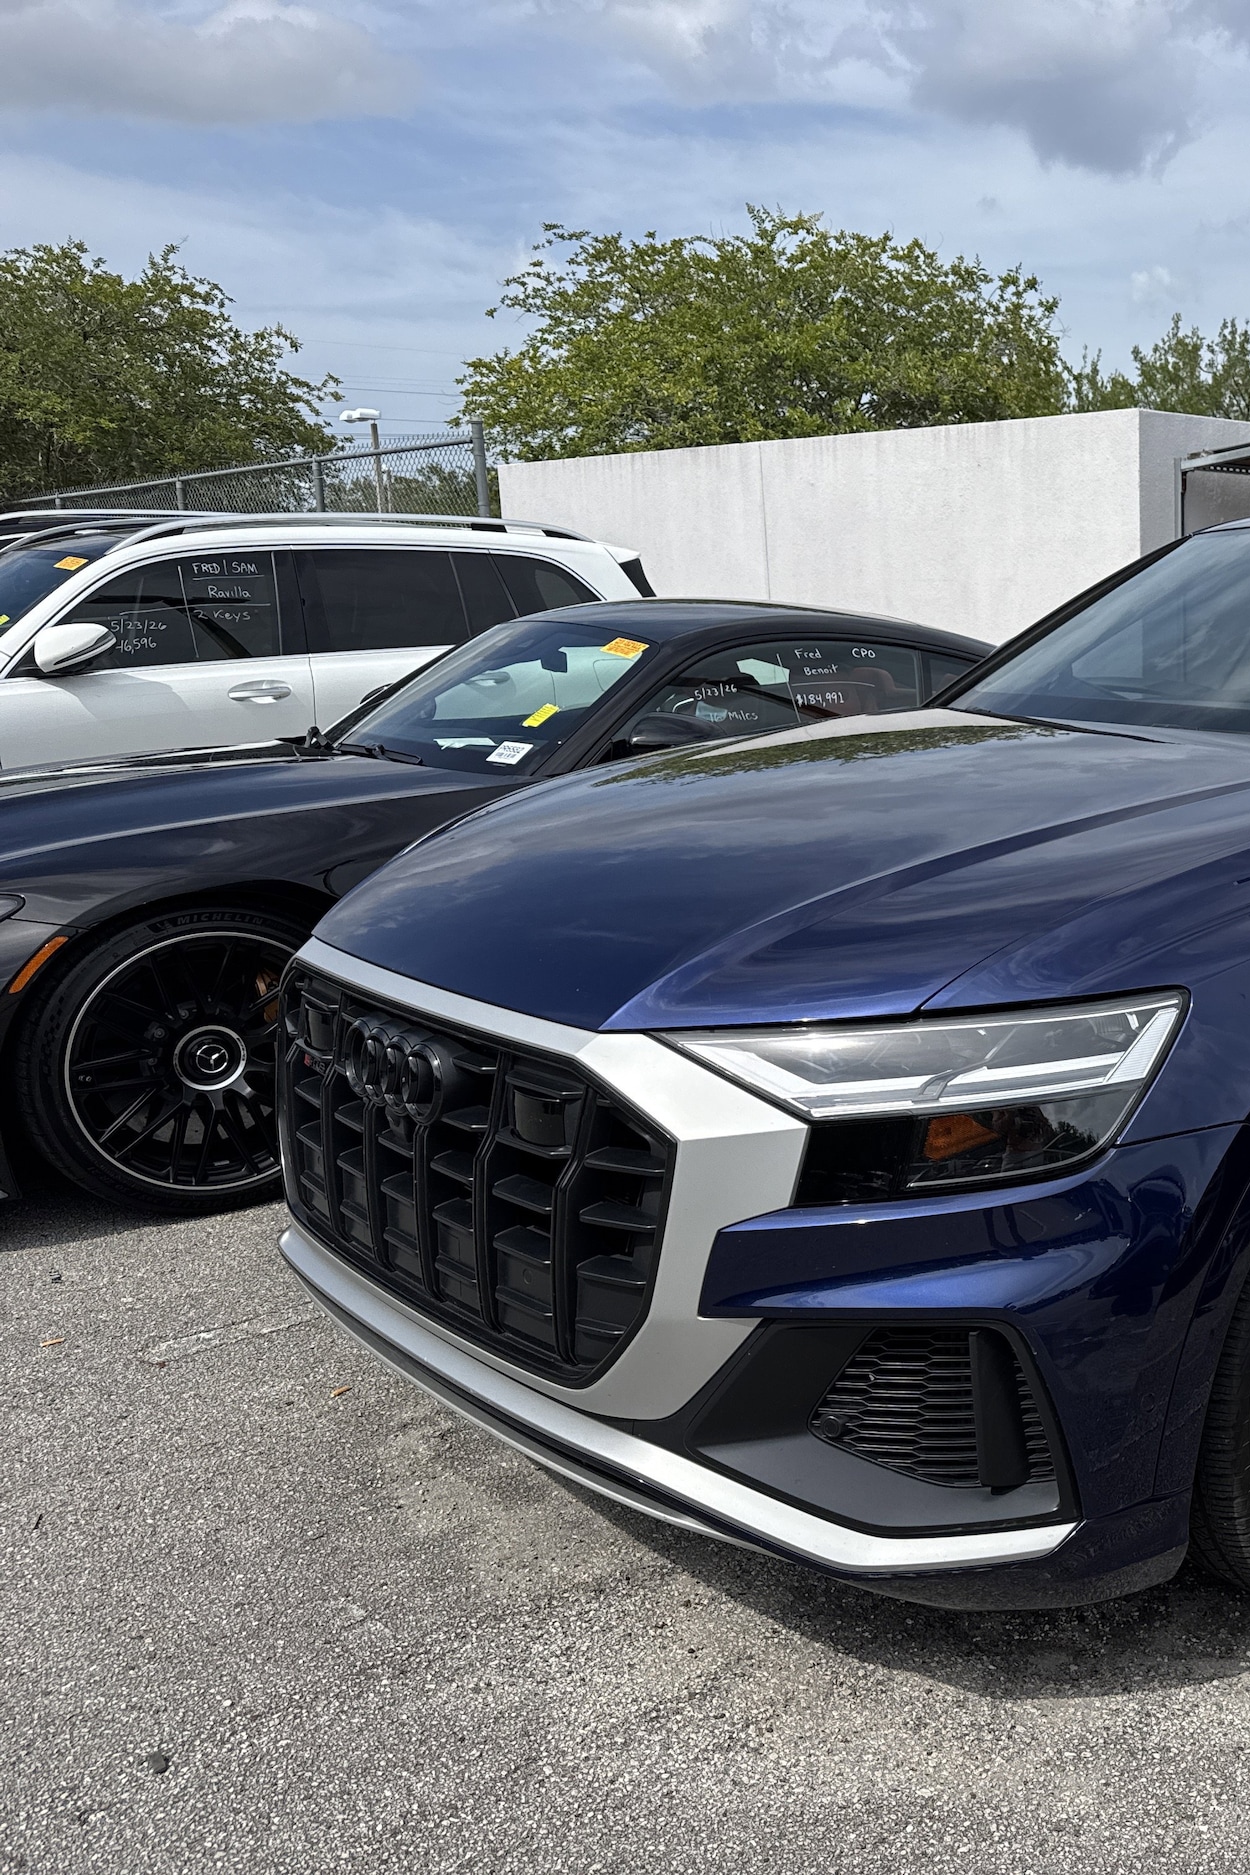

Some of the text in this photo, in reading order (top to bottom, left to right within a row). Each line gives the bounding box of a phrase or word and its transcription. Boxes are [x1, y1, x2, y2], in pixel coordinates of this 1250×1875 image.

[192, 562, 259, 574] FRED SAM
[207, 585, 251, 599] Ravilla
[194, 609, 251, 623] 2 Keys
[110, 618, 168, 634] 5/23/26
[794, 647, 876, 660] Fred CPO
[803, 663, 839, 677] Benoit
[694, 683, 738, 700] 5/23/26
[795, 692, 845, 708] $184,991
[176, 911, 264, 926] MICHELIN
